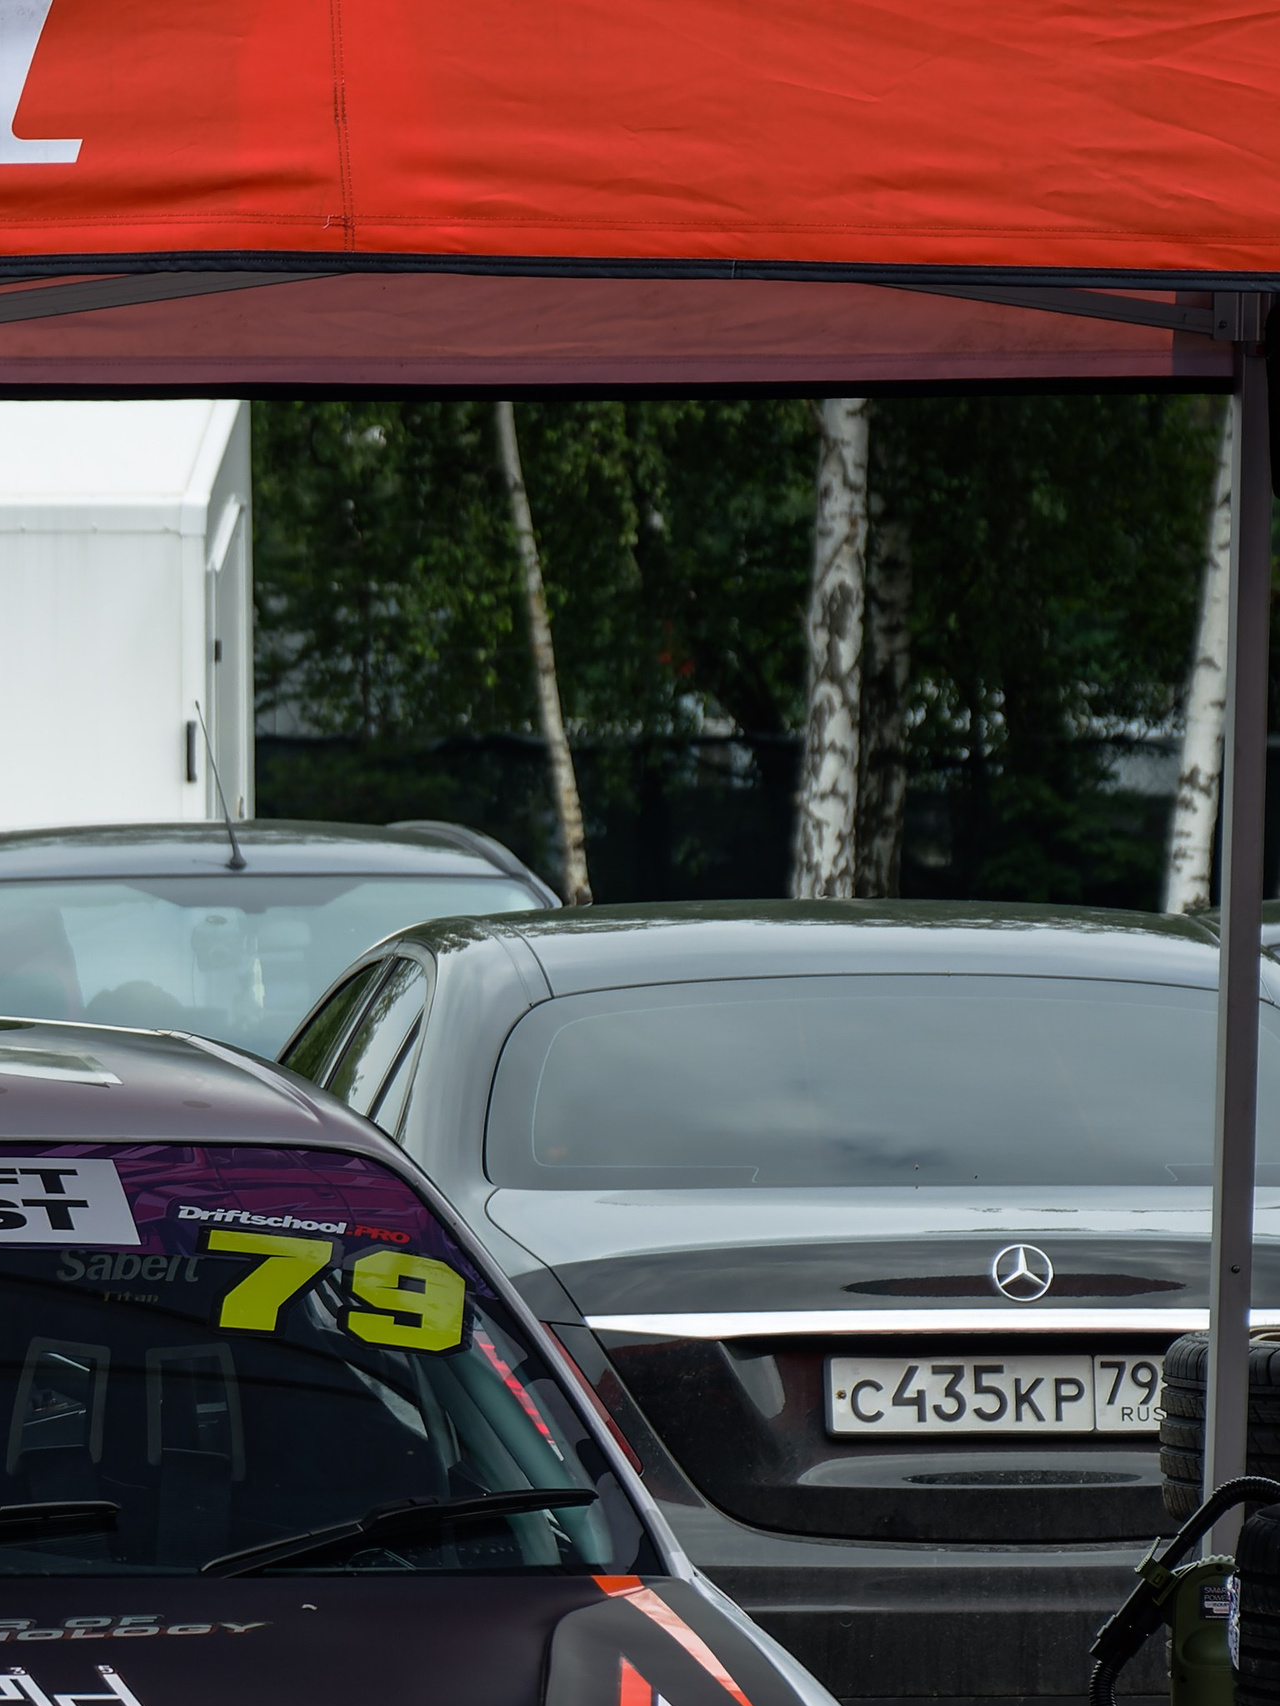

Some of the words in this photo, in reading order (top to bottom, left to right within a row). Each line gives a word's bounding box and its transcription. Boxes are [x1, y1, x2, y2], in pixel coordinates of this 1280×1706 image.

[207, 1229, 466, 1352] 79
[1122, 1406, 1167, 1421] RUS
[63, 1614, 163, 1628] OF
[98, 1664, 114, 1674] 5
